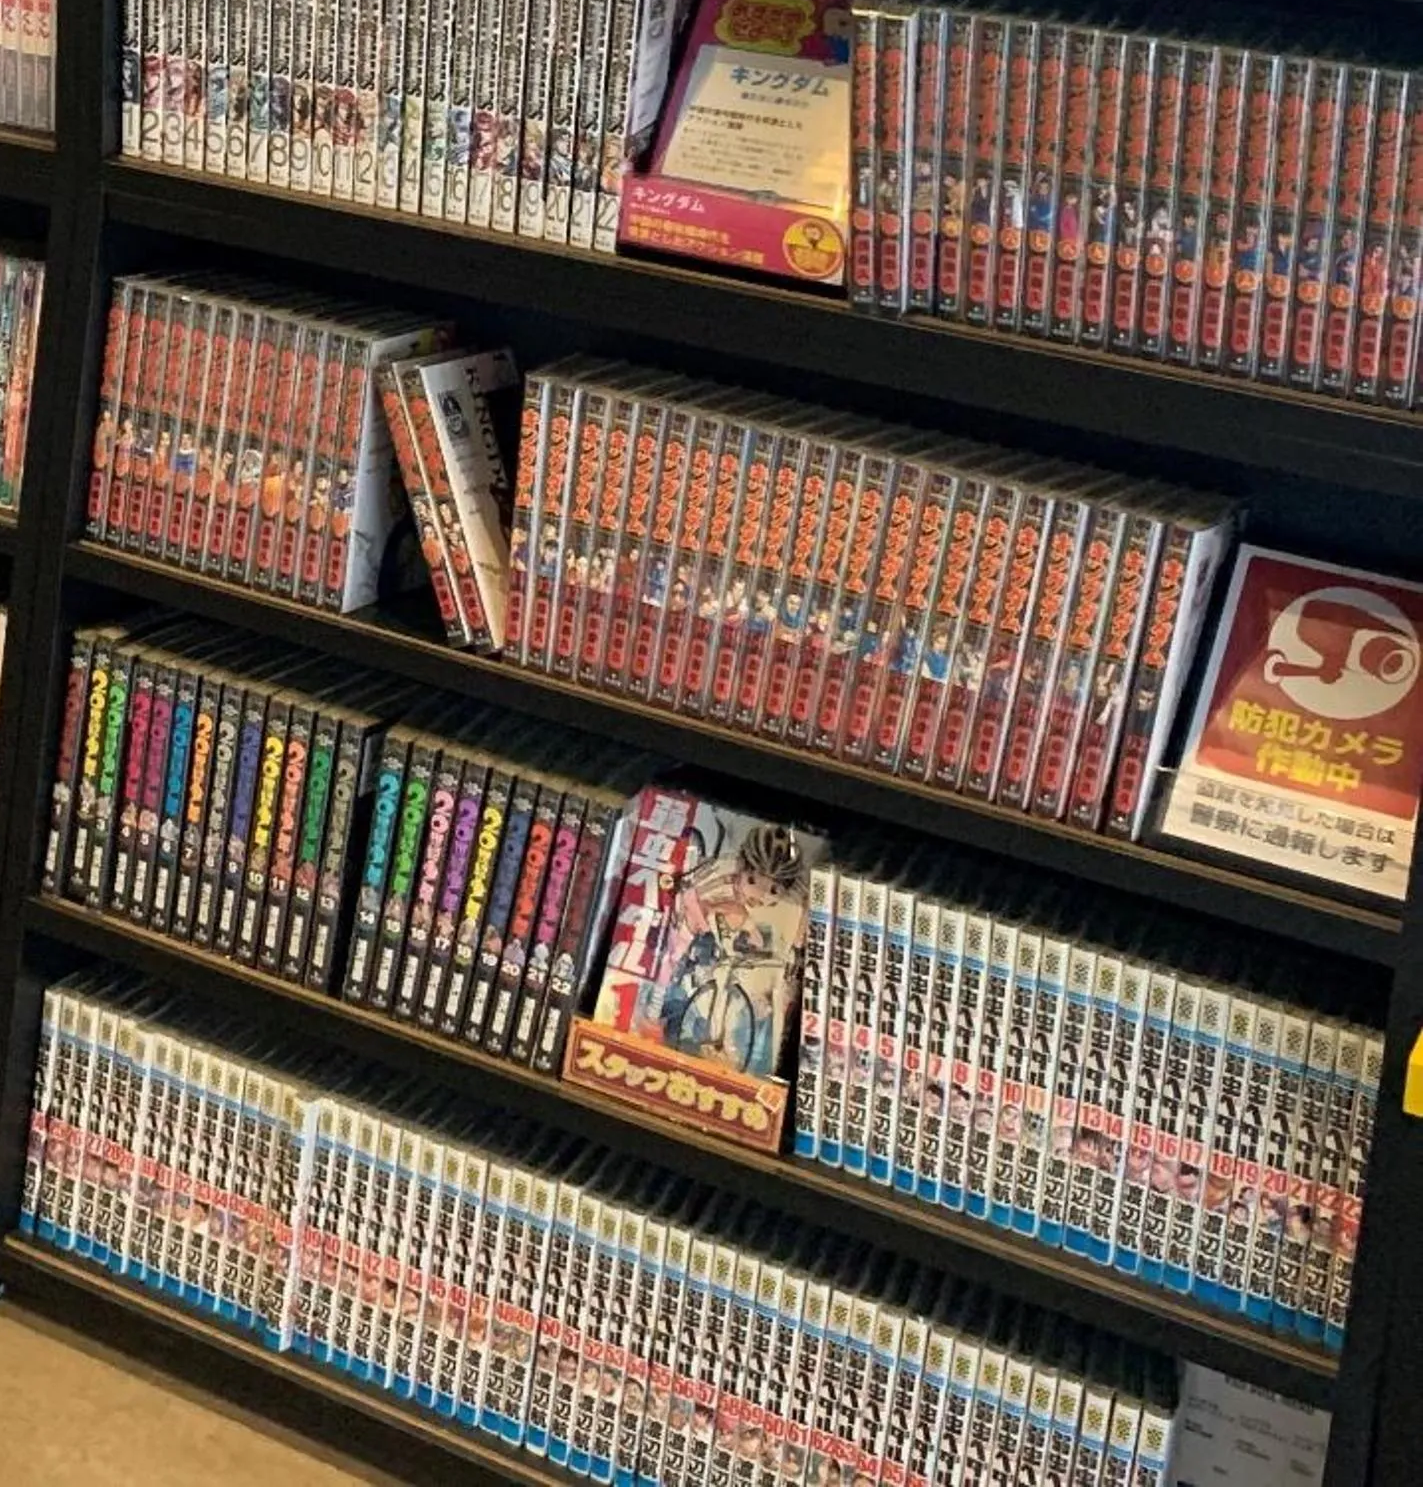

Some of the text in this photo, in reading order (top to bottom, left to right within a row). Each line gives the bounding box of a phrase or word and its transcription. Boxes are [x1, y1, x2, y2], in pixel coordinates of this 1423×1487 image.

[730, 66, 829, 97] キングダム
[143, 112, 158, 142] 2
[228, 125, 243, 157] 6
[270, 135, 287, 165] 8
[313, 143, 330, 176] 10
[496, 177, 513, 209] 18
[631, 185, 704, 212] キングダム
[596, 191, 615, 230] 22
[1229, 700, 1403, 766] 防犯カメラ
[1255, 744, 1361, 790] 作動中
[607, 796, 690, 979] 弱虫ペダル
[612, 983, 639, 1034] 1
[805, 1015, 817, 1032] 2
[881, 1037, 894, 1057] 5
[576, 1038, 767, 1130] スタッフおすすめ
[955, 1064, 967, 1082] 8
[1004, 1082, 1021, 1101] 10
[1132, 1124, 1152, 1145] 15
[1156, 1132, 1174, 1153] 16
[1212, 1155, 1231, 1174] 18
[1264, 1169, 1287, 1193] 20
[563, 1327, 579, 1345] 51
[696, 1387, 716, 1405] 57
[789, 1424, 807, 1444] 61
